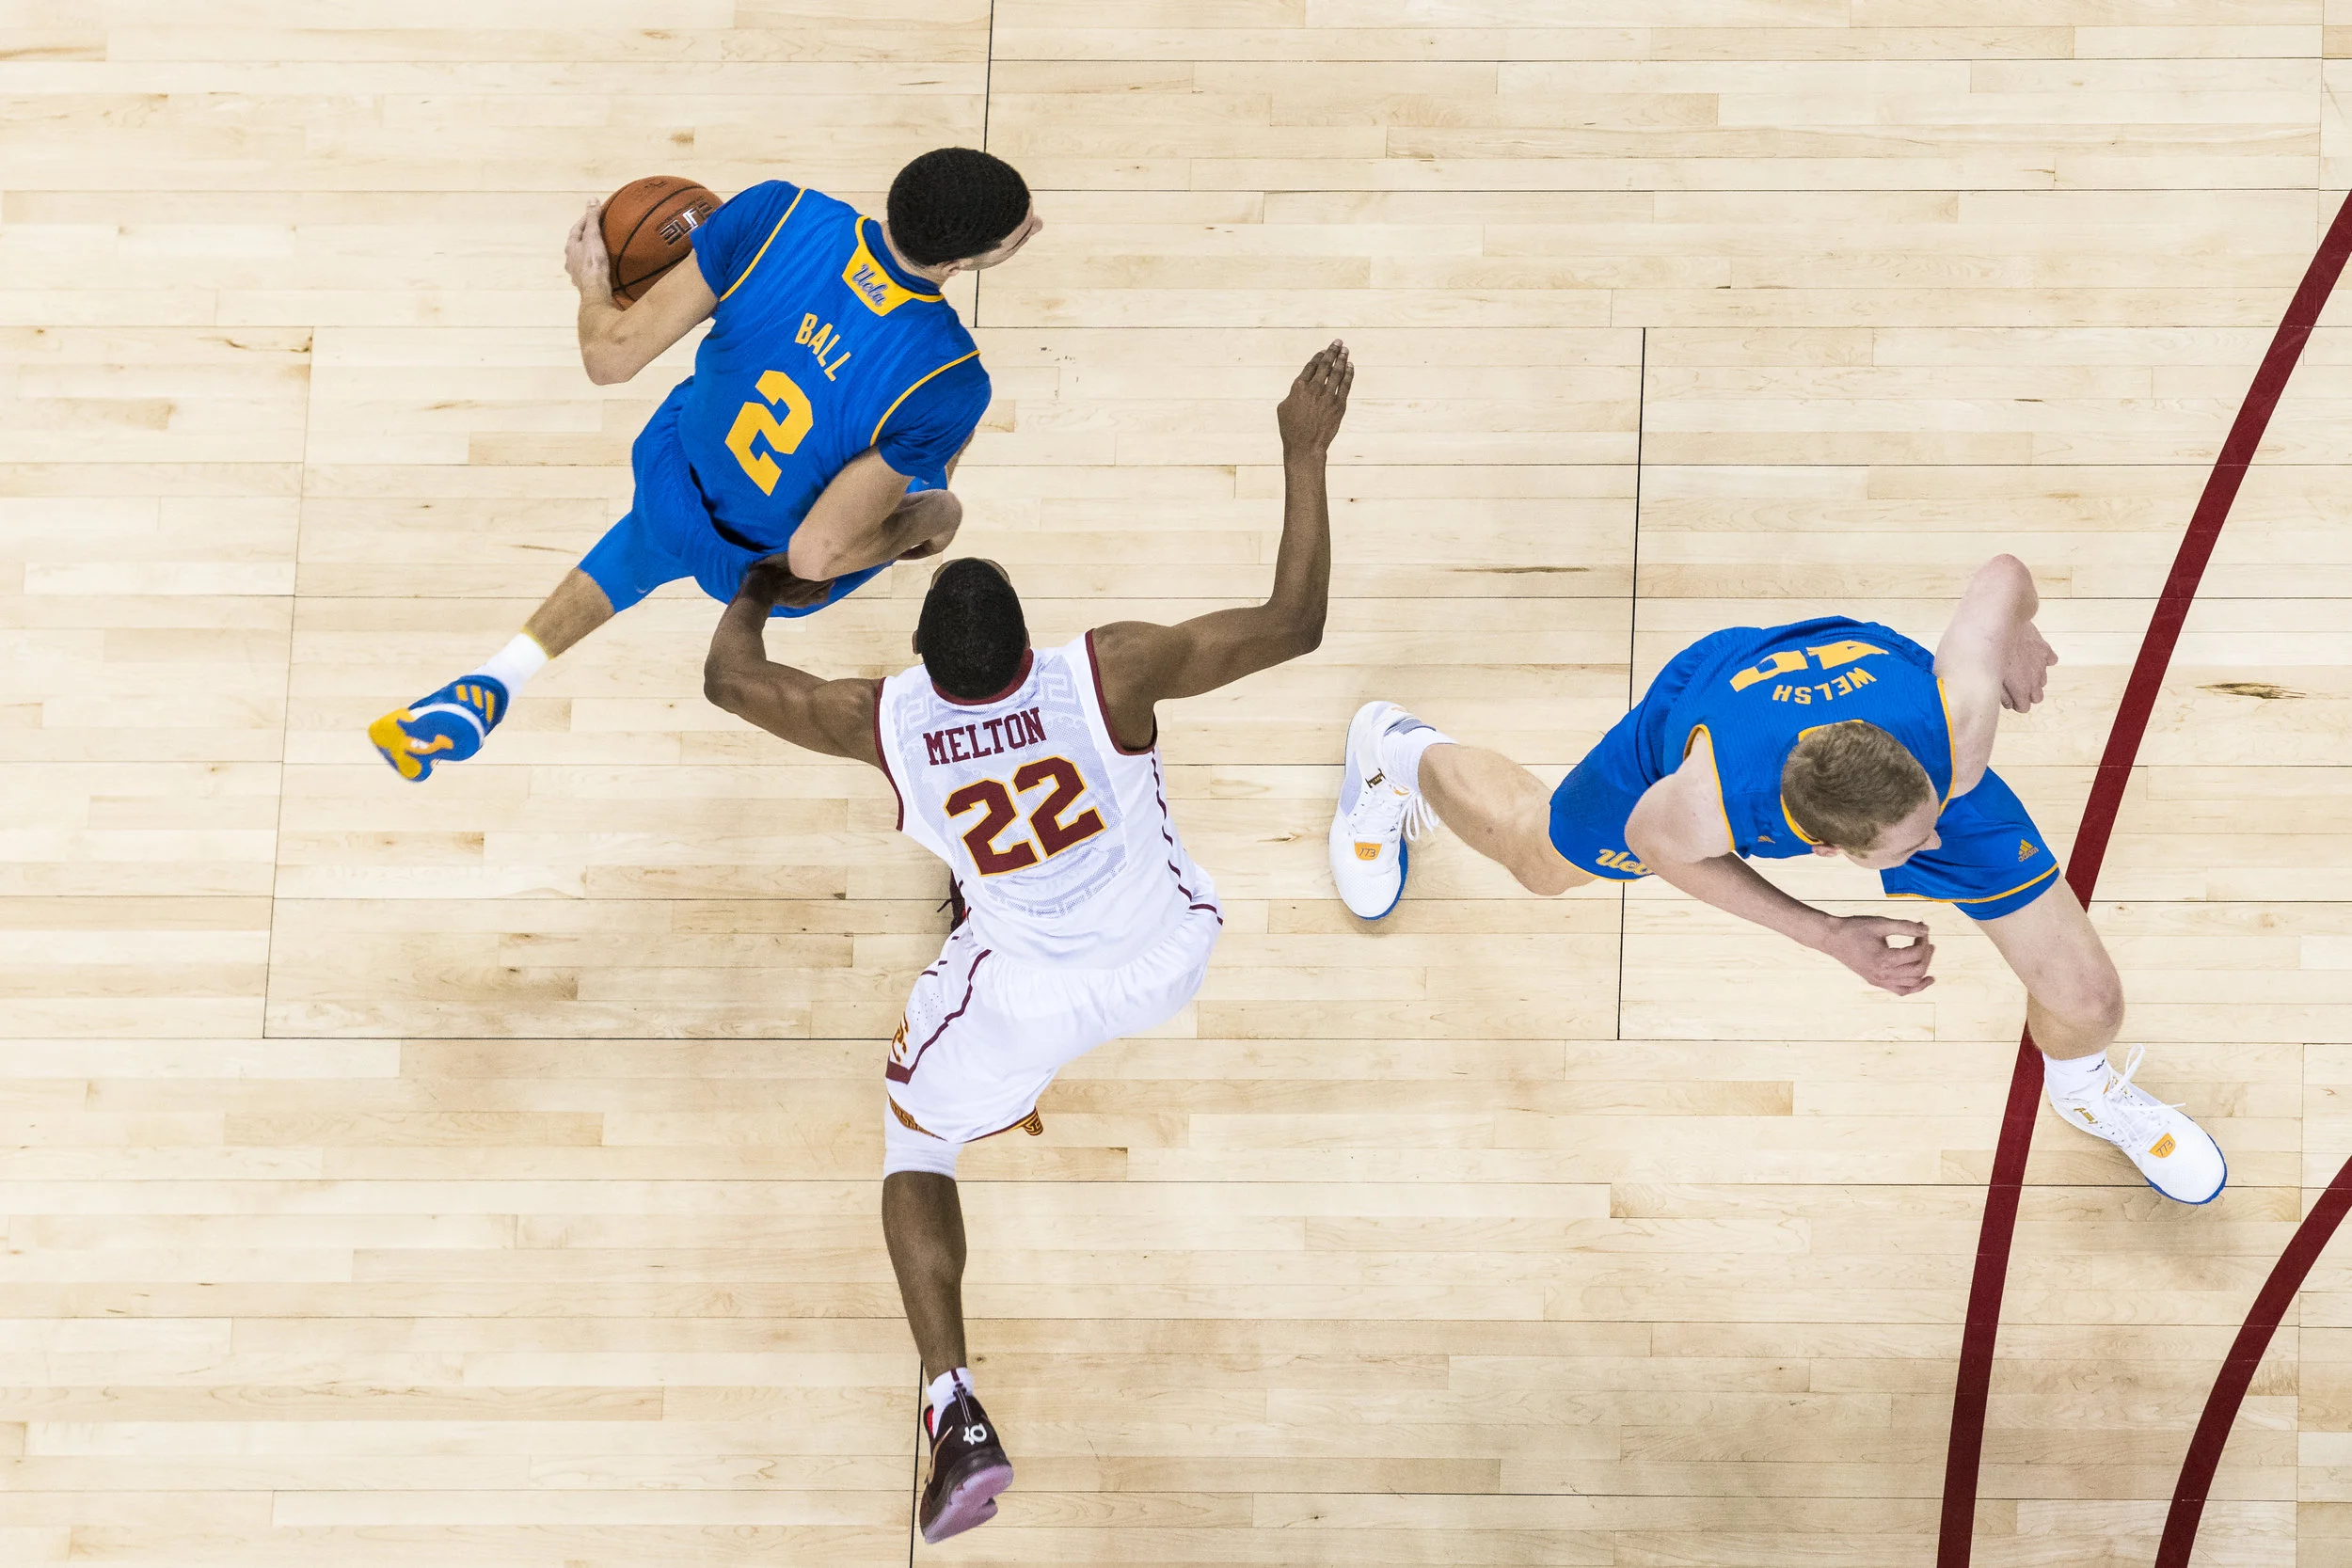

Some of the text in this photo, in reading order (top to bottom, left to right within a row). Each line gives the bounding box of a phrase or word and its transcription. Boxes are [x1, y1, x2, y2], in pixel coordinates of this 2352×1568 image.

[795, 313, 851, 382] BALL
[724, 370, 814, 497] 2
[1772, 667, 1877, 705] WELSH
[923, 706, 1047, 766] MELTON
[944, 755, 1107, 877] 22
